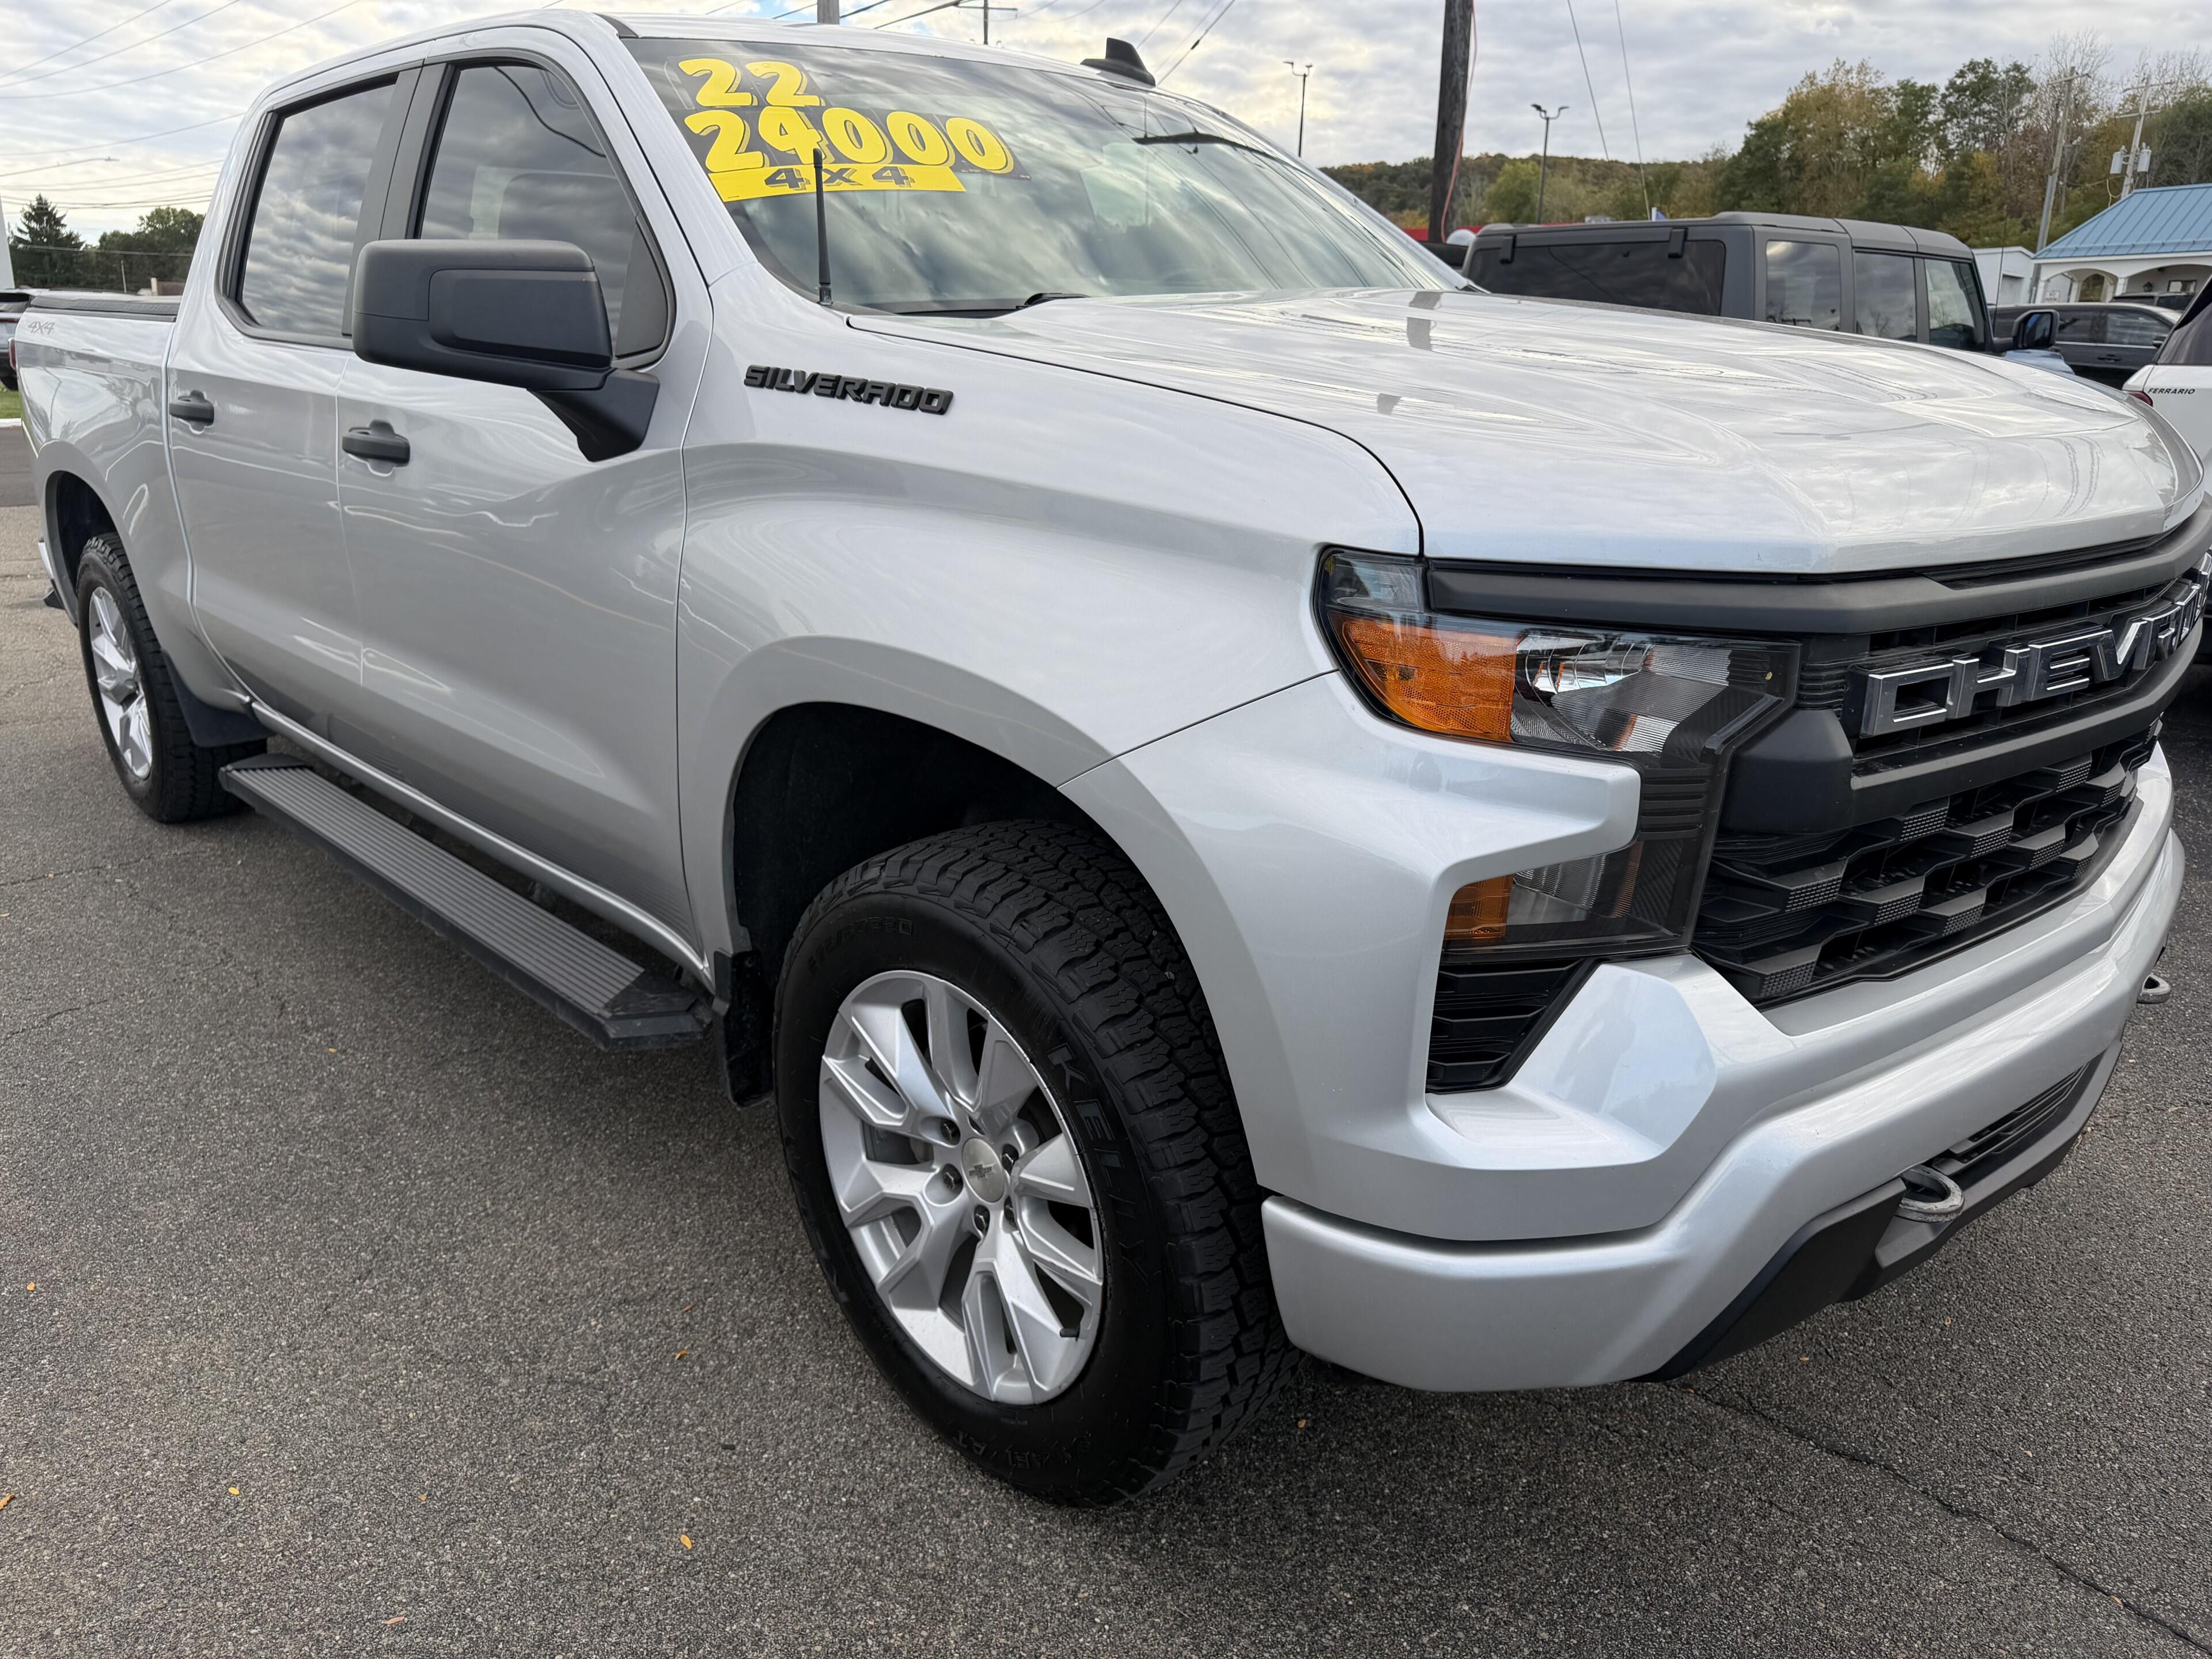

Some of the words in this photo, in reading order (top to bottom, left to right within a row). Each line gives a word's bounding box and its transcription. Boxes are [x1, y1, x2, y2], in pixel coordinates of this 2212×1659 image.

[679, 58, 825, 107] 22
[684, 106, 1014, 173] 24000
[744, 365, 954, 415] SILVERADO
[1859, 544, 2212, 736] CHEVRO
[1047, 1043, 1150, 1288] KELLY
